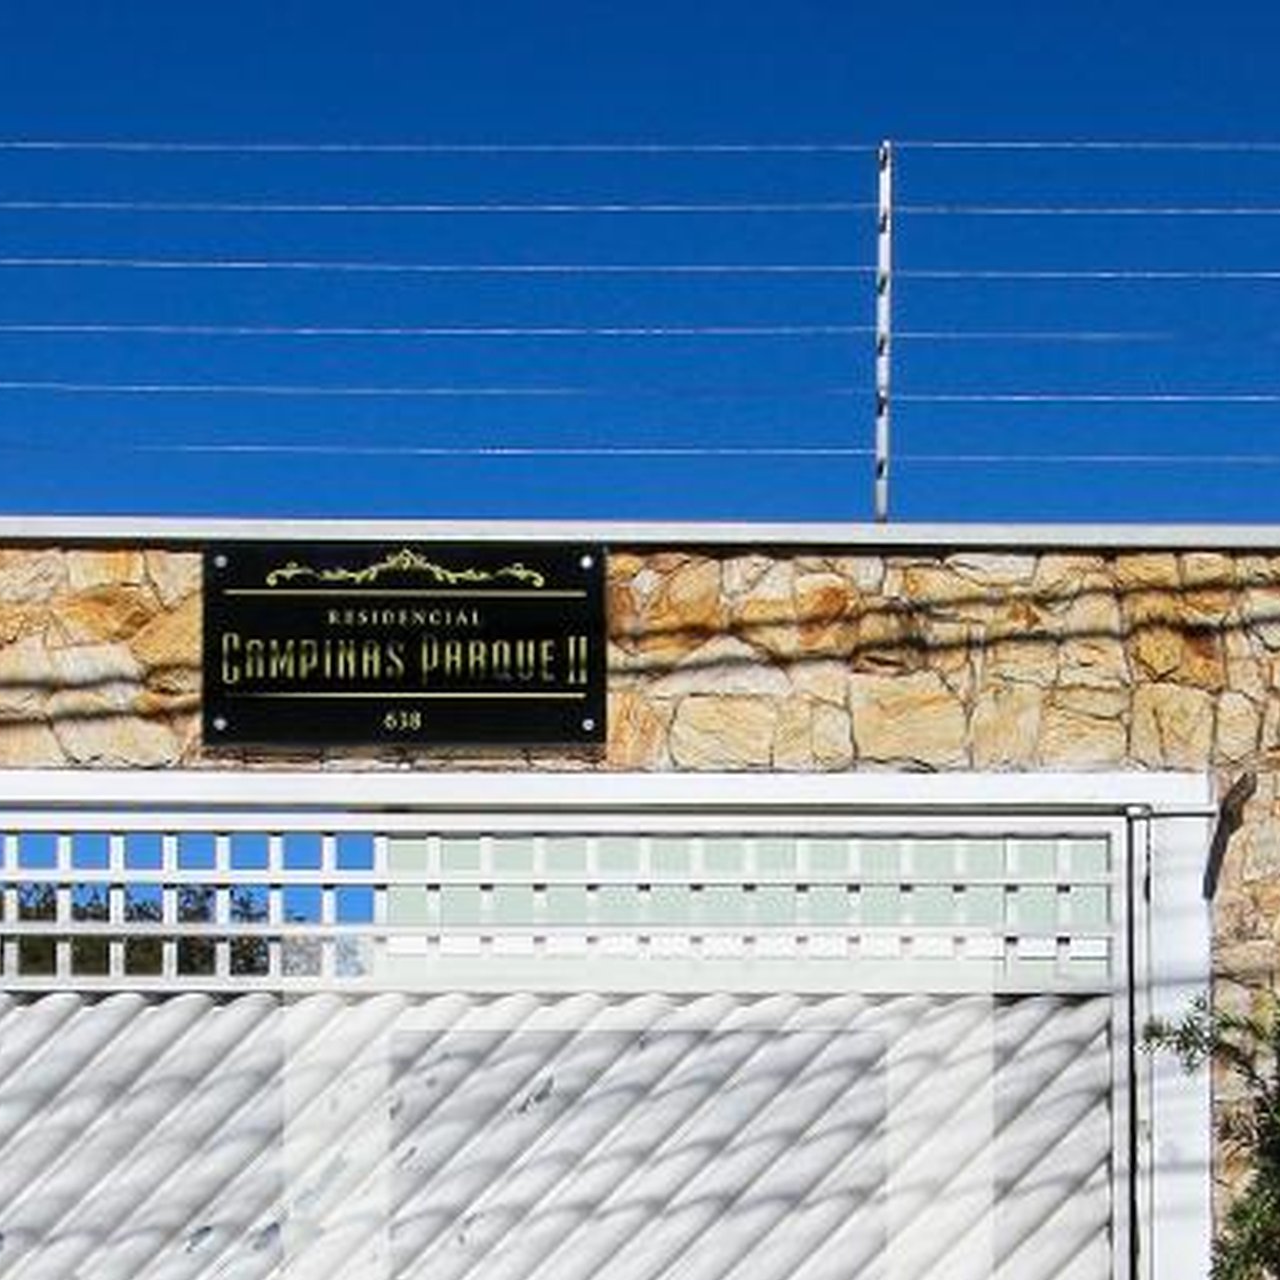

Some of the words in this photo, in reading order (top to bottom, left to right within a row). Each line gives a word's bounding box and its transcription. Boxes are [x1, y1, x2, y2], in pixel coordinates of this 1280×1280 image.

[328, 609, 480, 626] RESIDENCIAL
[222, 631, 405, 684] CAMPINAS
[422, 633, 556, 684] PARQUE
[568, 635, 588, 684] II
[383, 710, 422, 732] 638
